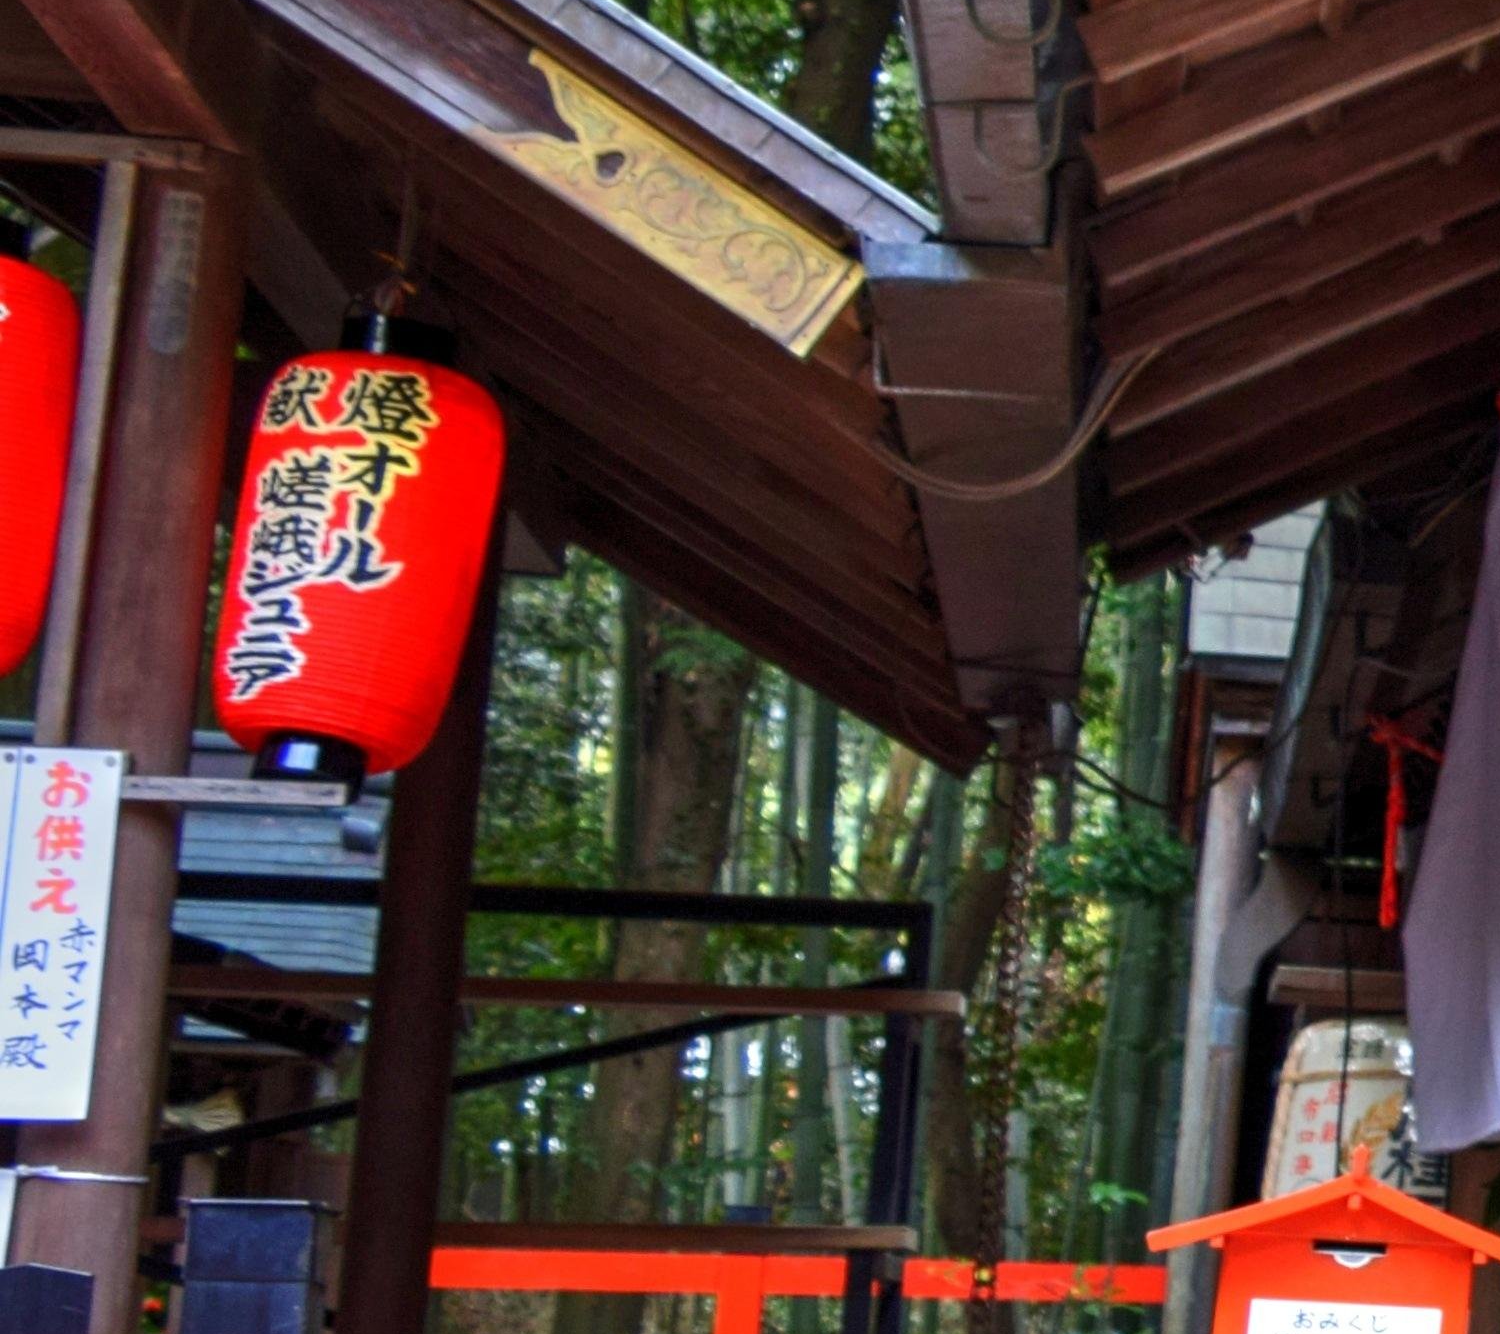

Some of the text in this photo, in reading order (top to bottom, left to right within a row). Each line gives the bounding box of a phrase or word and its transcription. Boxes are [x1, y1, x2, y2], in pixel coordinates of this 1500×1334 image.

[228, 454, 331, 698] 嵯峨ジュニア
[29, 760, 93, 915] お供え
[1292, 1308, 1388, 1334] おみくじ
